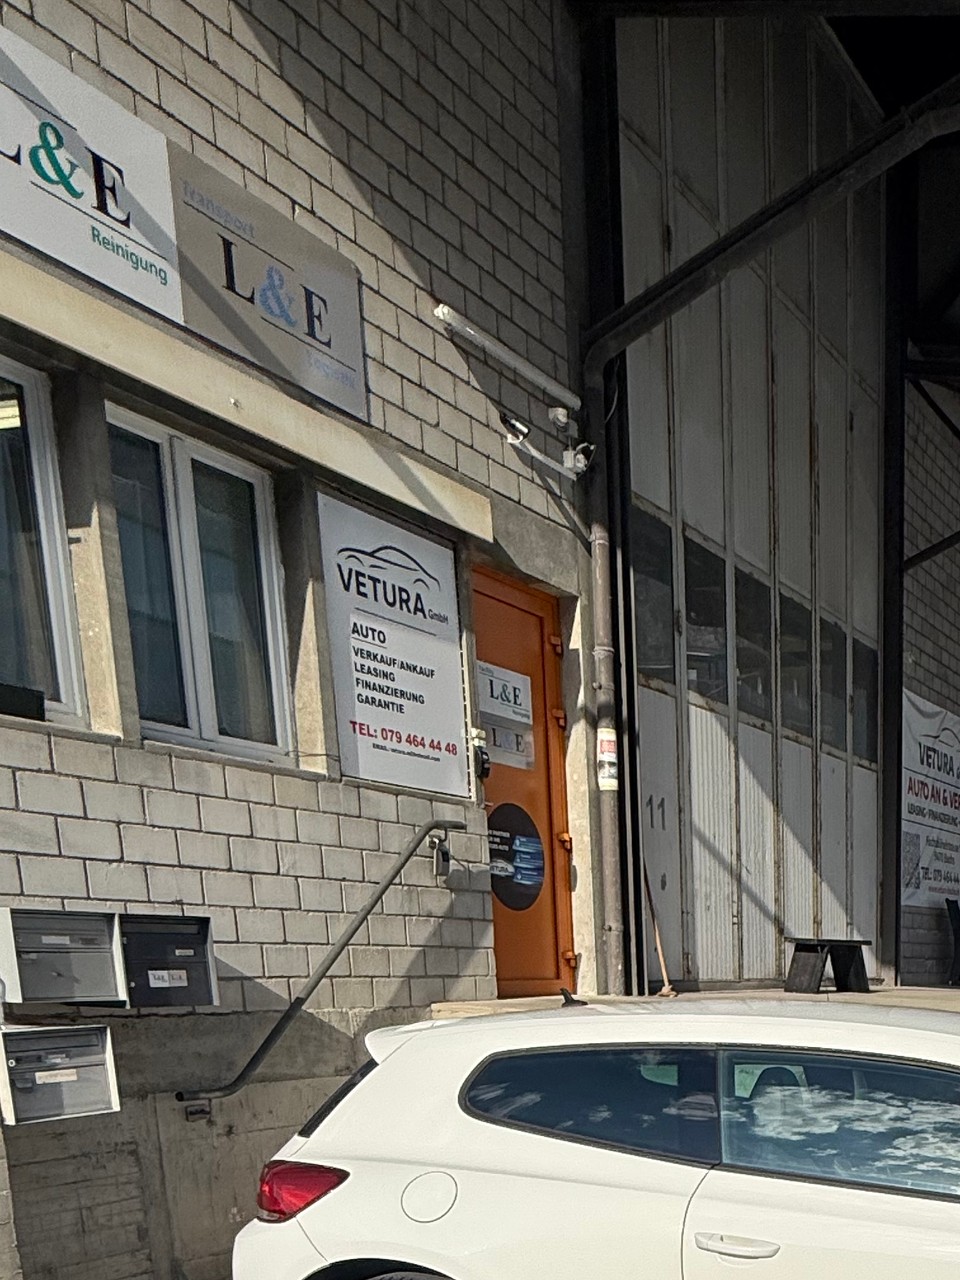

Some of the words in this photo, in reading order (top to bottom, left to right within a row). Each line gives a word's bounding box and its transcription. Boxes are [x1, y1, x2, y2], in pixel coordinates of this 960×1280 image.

[90, 224, 168, 286] Reinigung
[217, 232, 332, 349] L&E
[336, 562, 427, 619] VETURA
[351, 621, 387, 644] AUTO
[353, 661, 396, 682] LEASING
[355, 677, 426, 705] FINANZIERUNG
[356, 693, 406, 714] GARANTIE
[488, 678, 522, 707] L&E
[349, 720, 378, 739] TEL:
[380, 727, 403, 744] 079
[405, 733, 426, 749] 464
[428, 739, 442, 753] 44
[444, 742, 458, 756] 48
[918, 741, 955, 778] VETURA
[907, 776, 930, 800] AUTO
[930, 784, 941, 805] AN
[942, 788, 948, 806] &
[645, 794, 666, 831] 11
